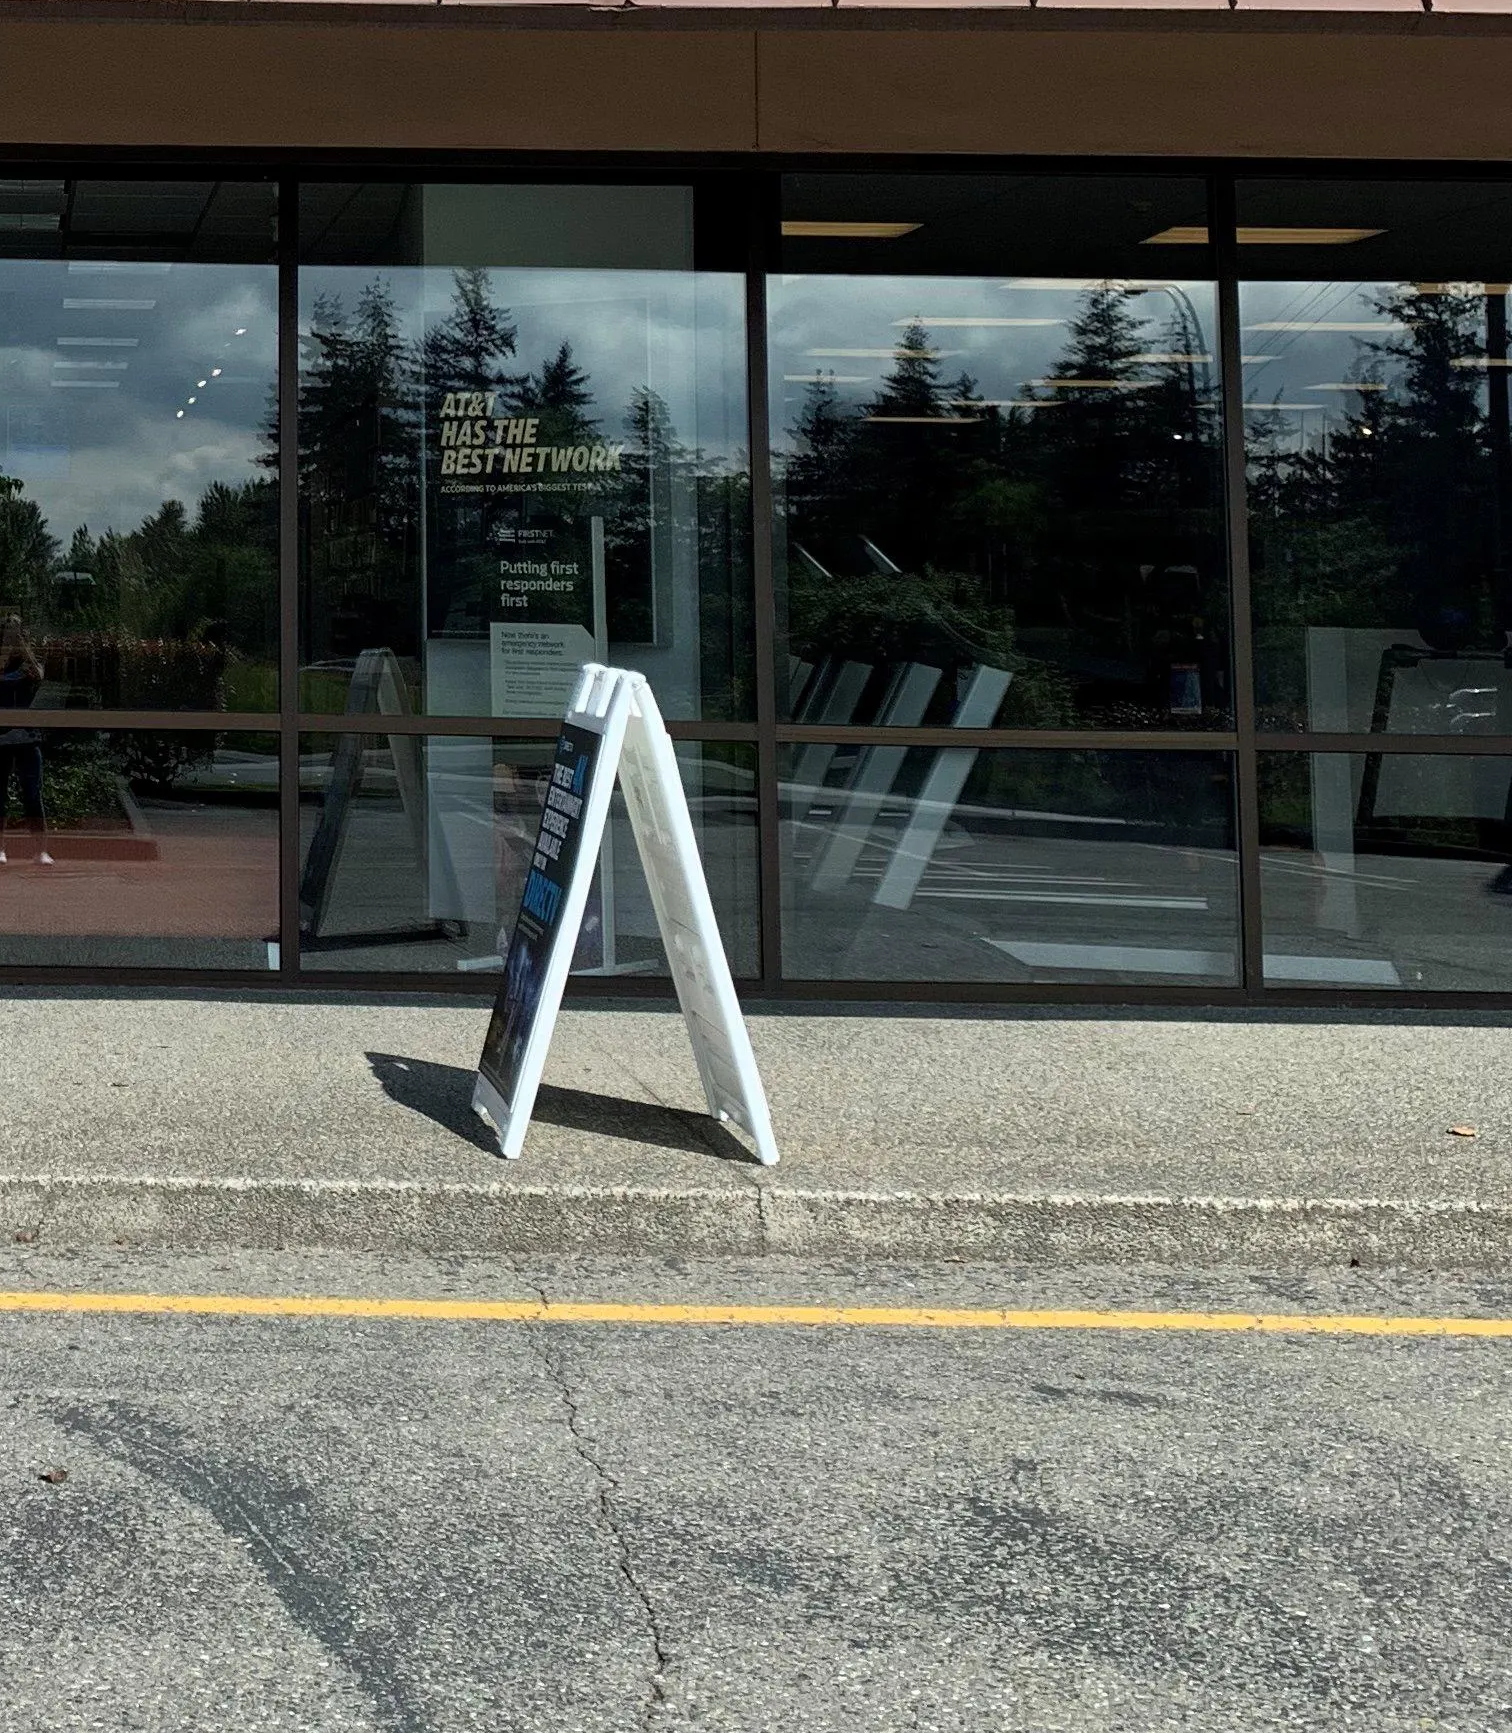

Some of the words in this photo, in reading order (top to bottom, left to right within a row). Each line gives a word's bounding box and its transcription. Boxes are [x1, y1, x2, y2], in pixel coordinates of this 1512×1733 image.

[440, 391, 498, 418] AT&T
[440, 420, 488, 447] HAS
[493, 418, 540, 445] THE
[441, 447, 500, 475] BEST
[502, 445, 625, 474] NETWORK
[440, 484, 485, 494] ACCORDING
[485, 484, 496, 493] TO
[500, 560, 548, 577] Putting
[550, 560, 580, 575] first
[500, 578, 575, 593] responders
[500, 593, 529, 608] first
